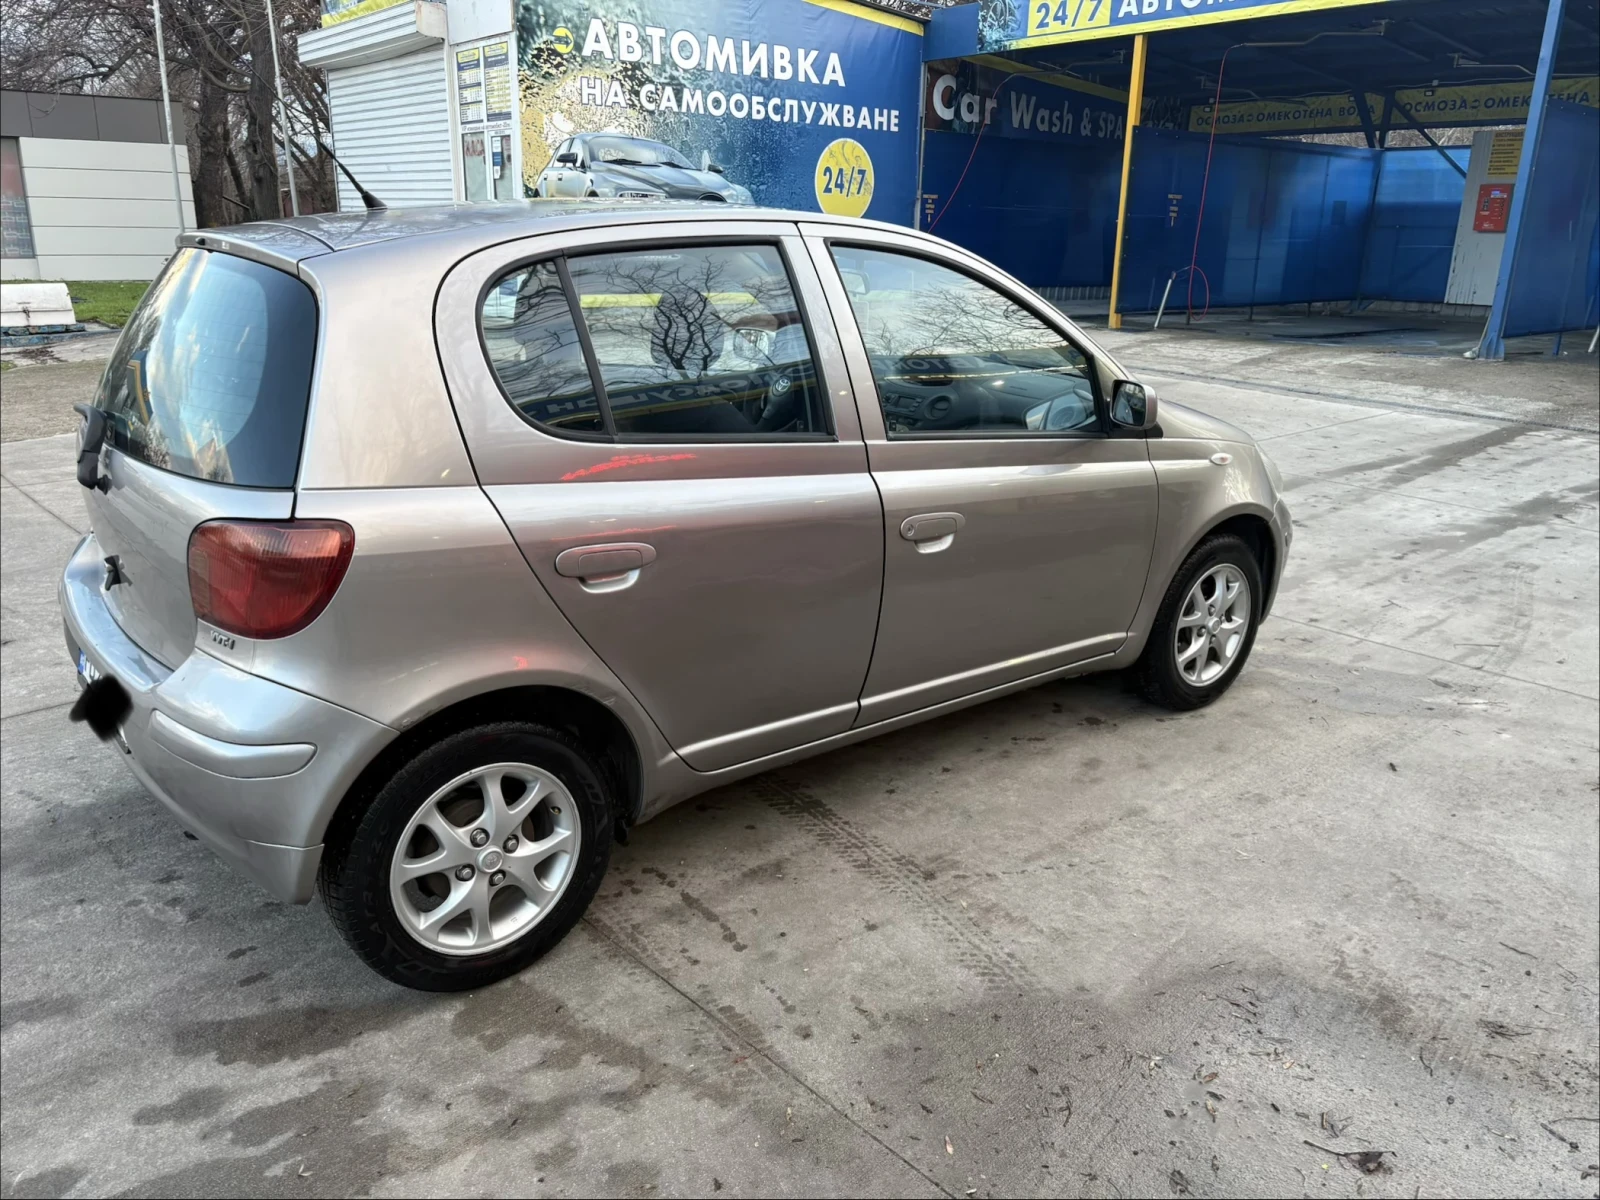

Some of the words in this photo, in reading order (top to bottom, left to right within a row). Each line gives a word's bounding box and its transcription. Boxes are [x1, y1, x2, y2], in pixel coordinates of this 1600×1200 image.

[1035, 0, 1104, 29] 24/7
[581, 17, 846, 87] АВТОМИВКА
[580, 77, 627, 107] НА
[639, 82, 899, 132] САМООБСЛУЖВАНЕ
[933, 74, 997, 125] Car
[1010, 91, 1073, 135] Wash
[1080, 107, 1092, 137] &
[1098, 111, 1123, 140] SPA
[1256, 107, 1333, 122] ОМЕКОТЕНА
[822, 165, 868, 199] 24/7
